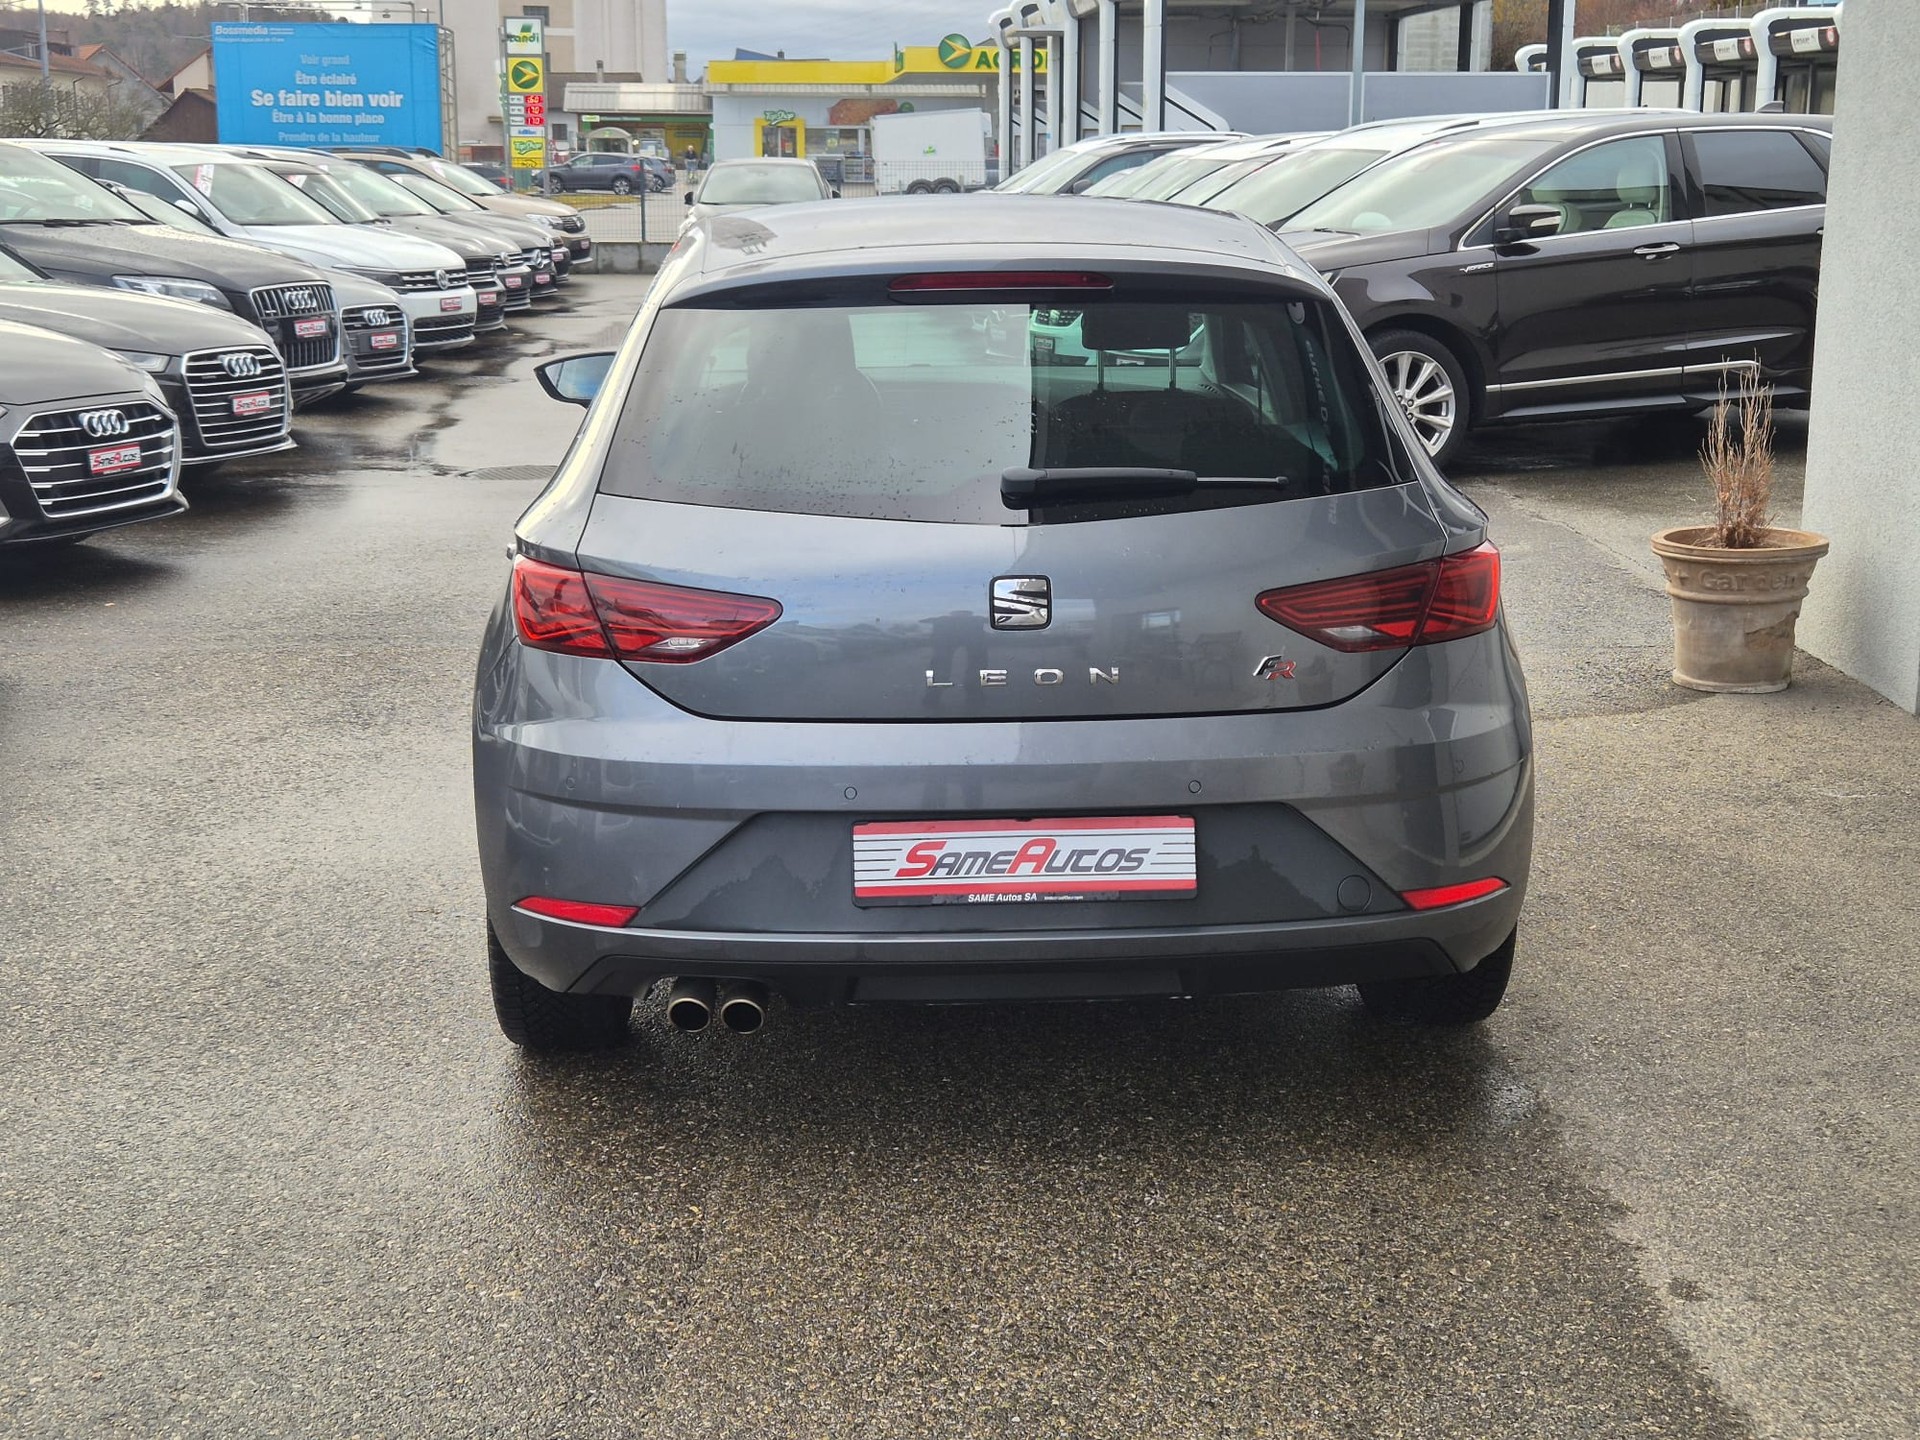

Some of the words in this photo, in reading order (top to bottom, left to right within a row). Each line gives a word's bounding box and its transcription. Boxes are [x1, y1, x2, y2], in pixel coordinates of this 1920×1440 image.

[301, 55, 319, 65] Voir
[322, 55, 350, 67] grand
[295, 71, 317, 85] Être
[320, 73, 357, 85] éclairé
[251, 89, 274, 107] Se
[278, 90, 320, 107] faire
[325, 90, 364, 107] bien
[368, 91, 404, 107] voir
[272, 109, 294, 123] Être
[296, 110, 304, 123] à
[306, 112, 317, 123] la
[319, 112, 352, 124] bonne
[355, 113, 385, 126] place
[278, 132, 316, 142] Prendre
[318, 132, 330, 142] de
[331, 132, 341, 142] la
[1700, 569, 1796, 592] Garden
[1253, 654, 1297, 681] FR
[925, 667, 1119, 688] LEON
[968, 893, 994, 903] SAME
[997, 893, 1022, 902] Autos
[1024, 892, 1037, 901] SA
